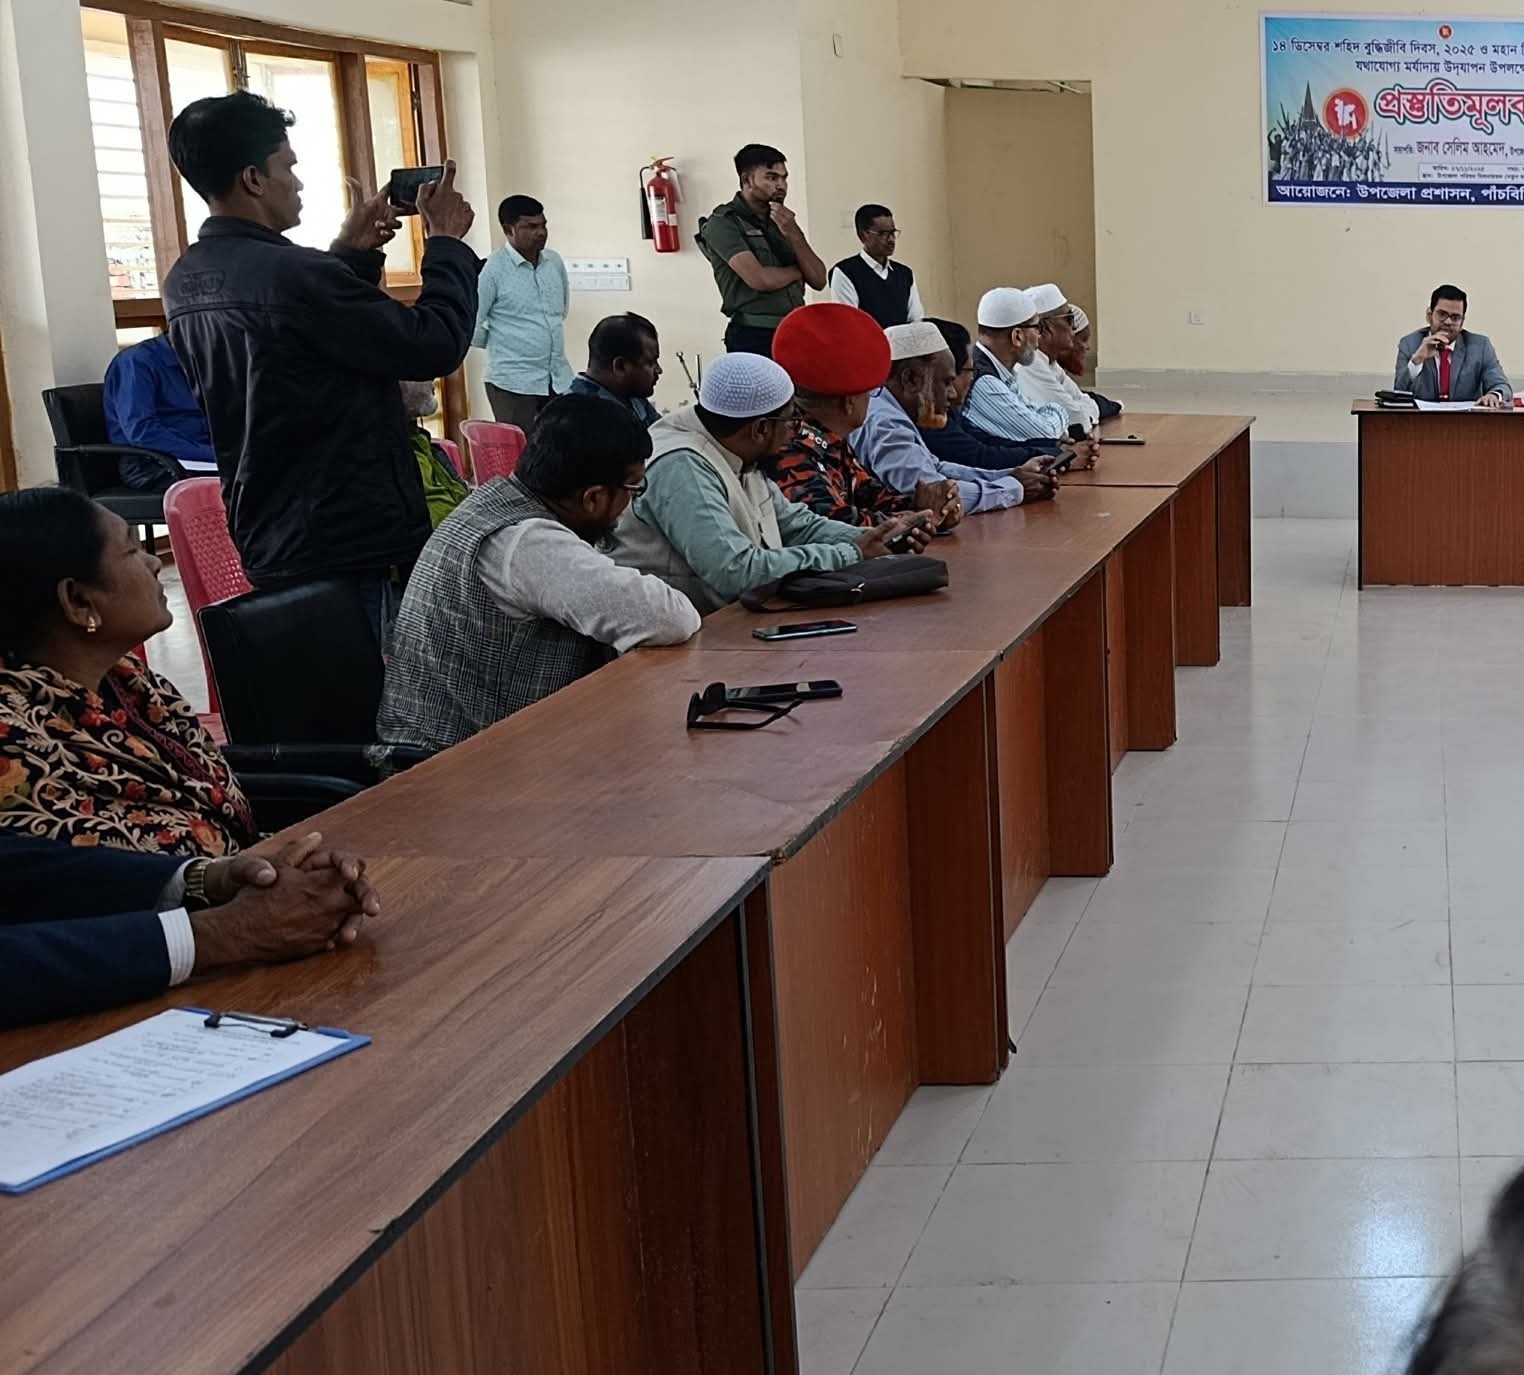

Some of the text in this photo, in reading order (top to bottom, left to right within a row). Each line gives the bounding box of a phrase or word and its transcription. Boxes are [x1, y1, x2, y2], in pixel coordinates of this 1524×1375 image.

[1272, 40, 1286, 52] ১৪
[1291, 37, 1330, 52] ডিসেম্বর
[1334, 39, 1360, 53] শহিদ
[1410, 40, 1440, 56] দিবস,
[1444, 44, 1475, 55] ২০২৫
[1480, 44, 1488, 54] ও
[1492, 43, 1517, 55] মহান
[1355, 60, 1401, 73] যথাযোগ্য
[1405, 58, 1440, 73] মর্যাদায়
[1416, 140, 1440, 155] জনাব
[1442, 136, 1469, 155] সেলিম
[1472, 141, 1508, 158] আহমেদ,
[1357, 183, 1416, 200] উপজেলা
[1420, 186, 1476, 202] প্রশাসন,
